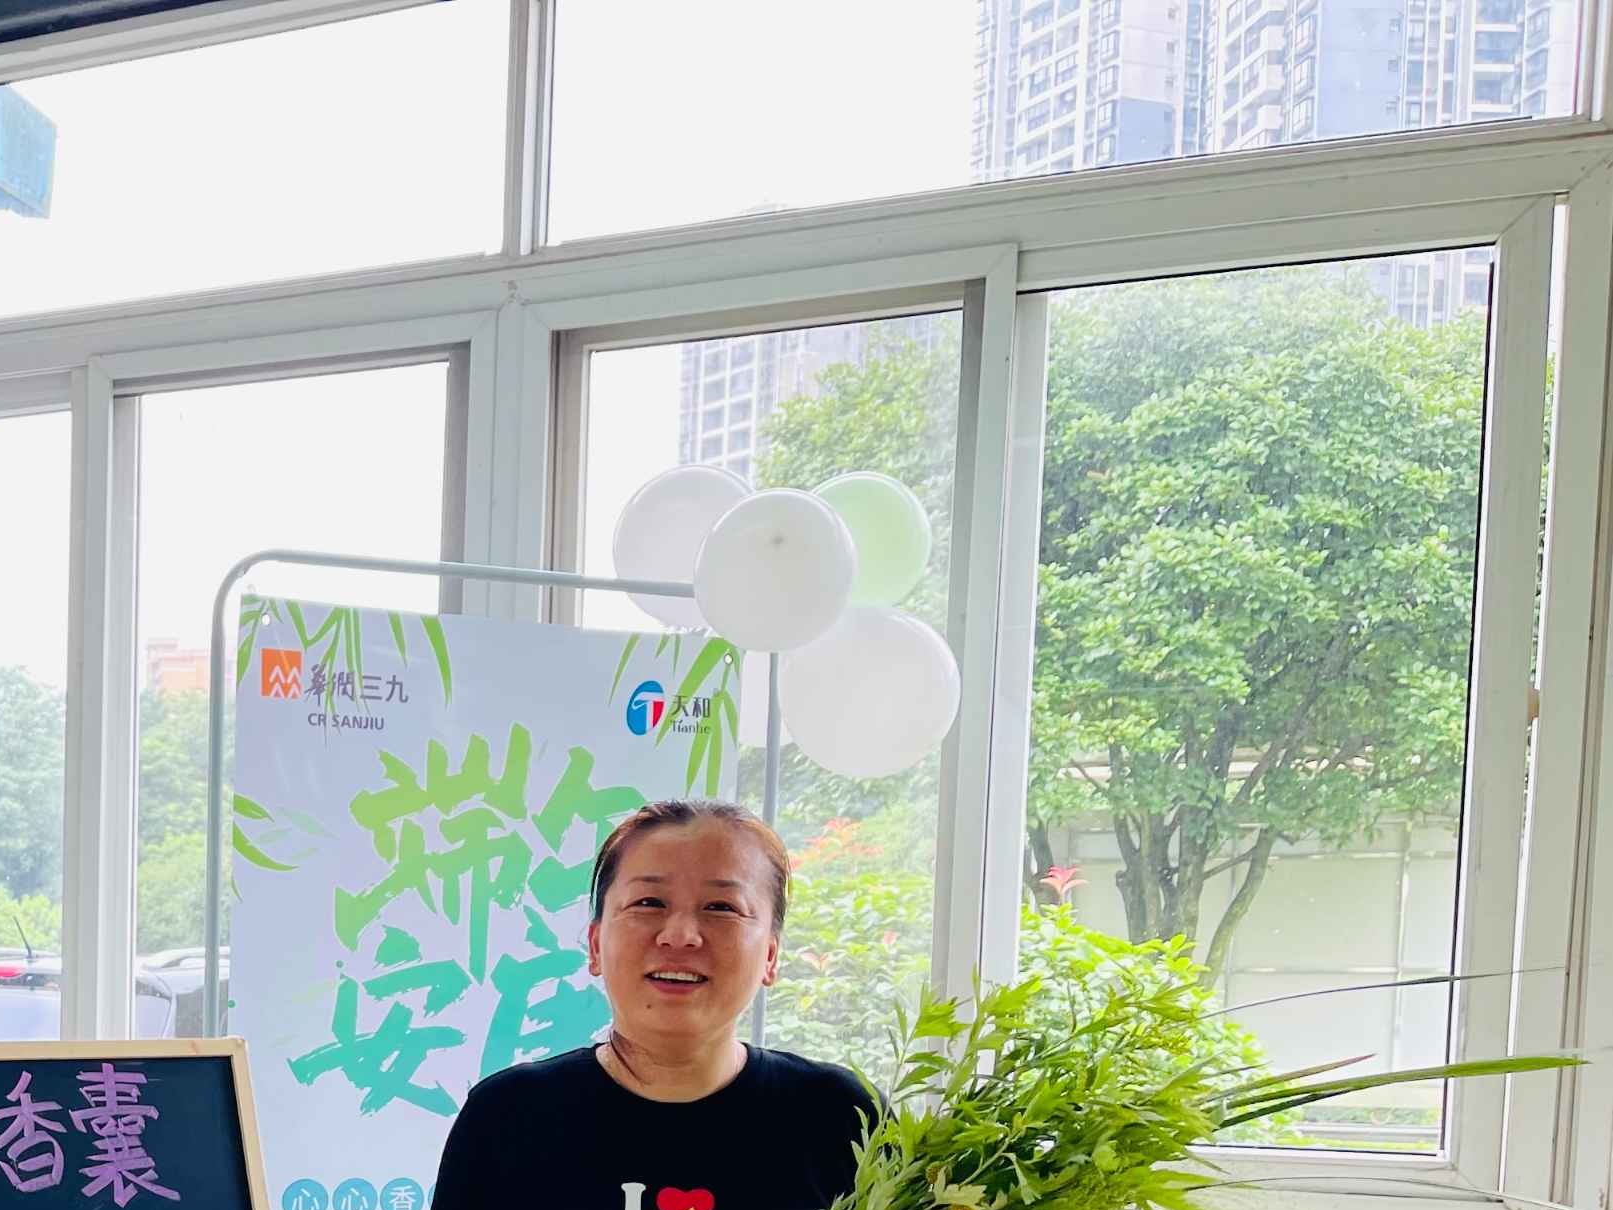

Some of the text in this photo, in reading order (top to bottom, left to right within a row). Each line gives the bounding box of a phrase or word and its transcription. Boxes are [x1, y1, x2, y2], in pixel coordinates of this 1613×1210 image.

[671, 694, 711, 718] 天和
[307, 713, 385, 730] CR SANJIU
